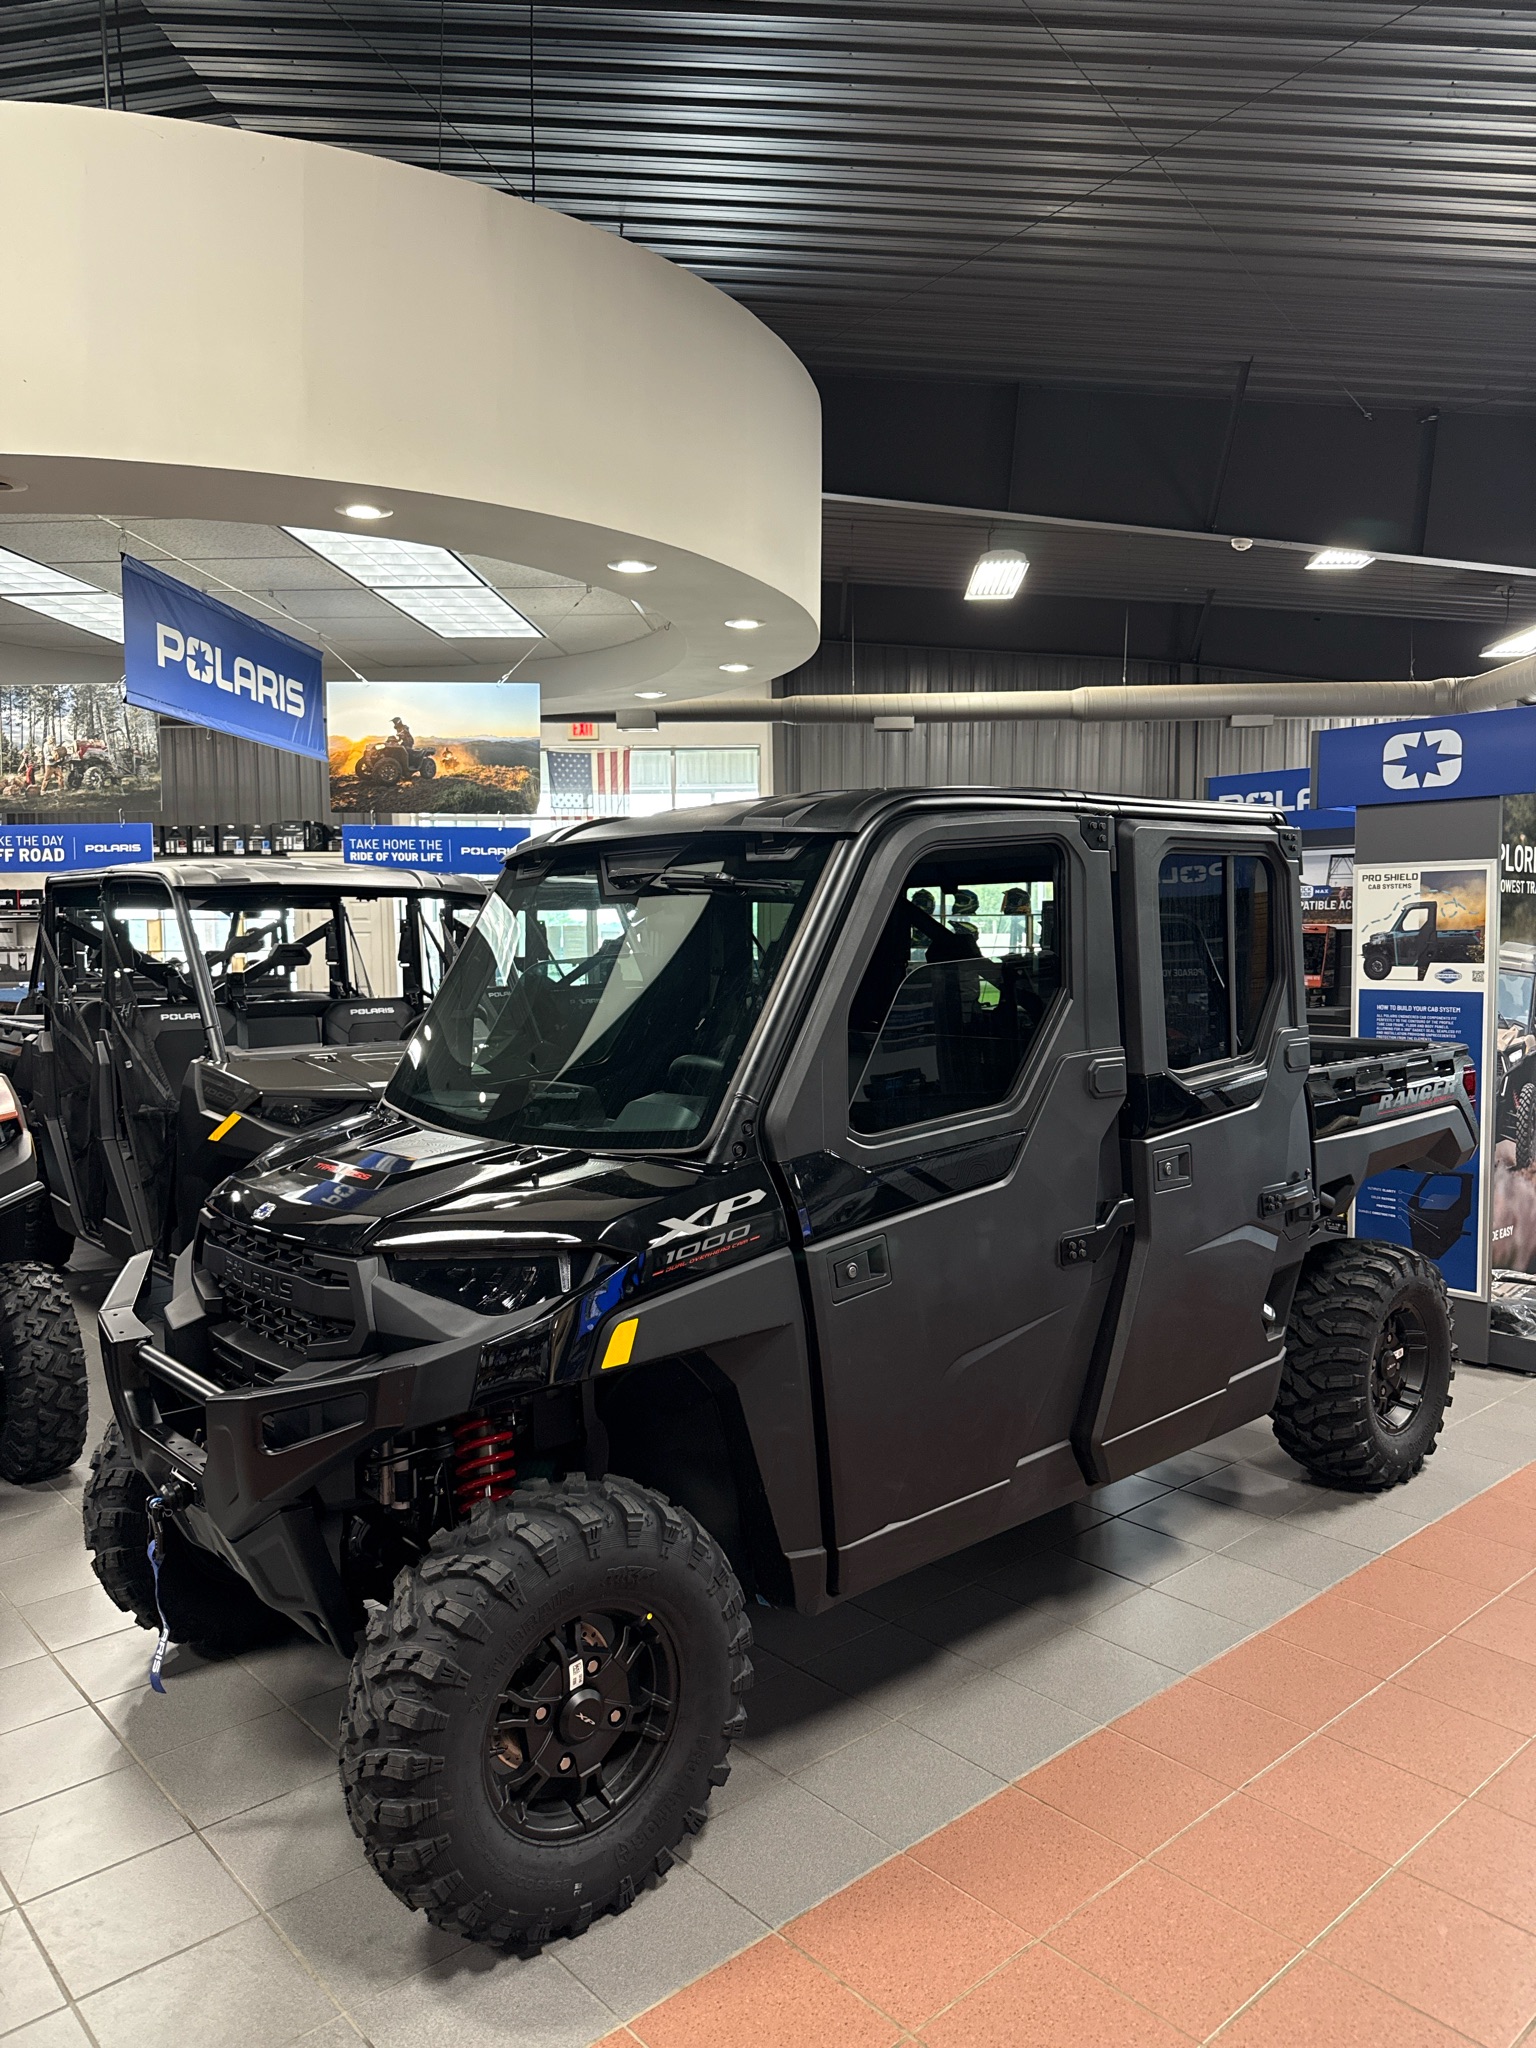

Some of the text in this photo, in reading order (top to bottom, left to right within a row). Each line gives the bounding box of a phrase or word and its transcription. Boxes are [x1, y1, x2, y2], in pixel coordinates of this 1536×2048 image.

[156, 622, 306, 719] POLARIS
[573, 722, 593, 736] EXIT
[16, 836, 39, 846] THE
[42, 835, 64, 846] DAY
[350, 838, 443, 850] TAKE HOME THE
[85, 844, 141, 852] POLARIS
[19, 848, 65, 862] ROAD
[350, 852, 443, 862] RIDE OF YOUR LIFE
[1362, 873, 1418, 882] PRO SHIELD
[1526, 881, 1536, 894] TR
[160, 1013, 201, 1021] POLAR
[350, 1007, 395, 1015] POLARIS
[1378, 1080, 1456, 1111] RANGER
[647, 1188, 767, 1250] XP
[1499, 1225, 1513, 1238] EASY
[666, 1224, 751, 1264] 1000
[689, 1244, 731, 1264] OVERHEAD
[732, 1239, 749, 1249] CAM
[224, 1256, 293, 1301] POLARIS
[575, 1712, 596, 1725] XP
